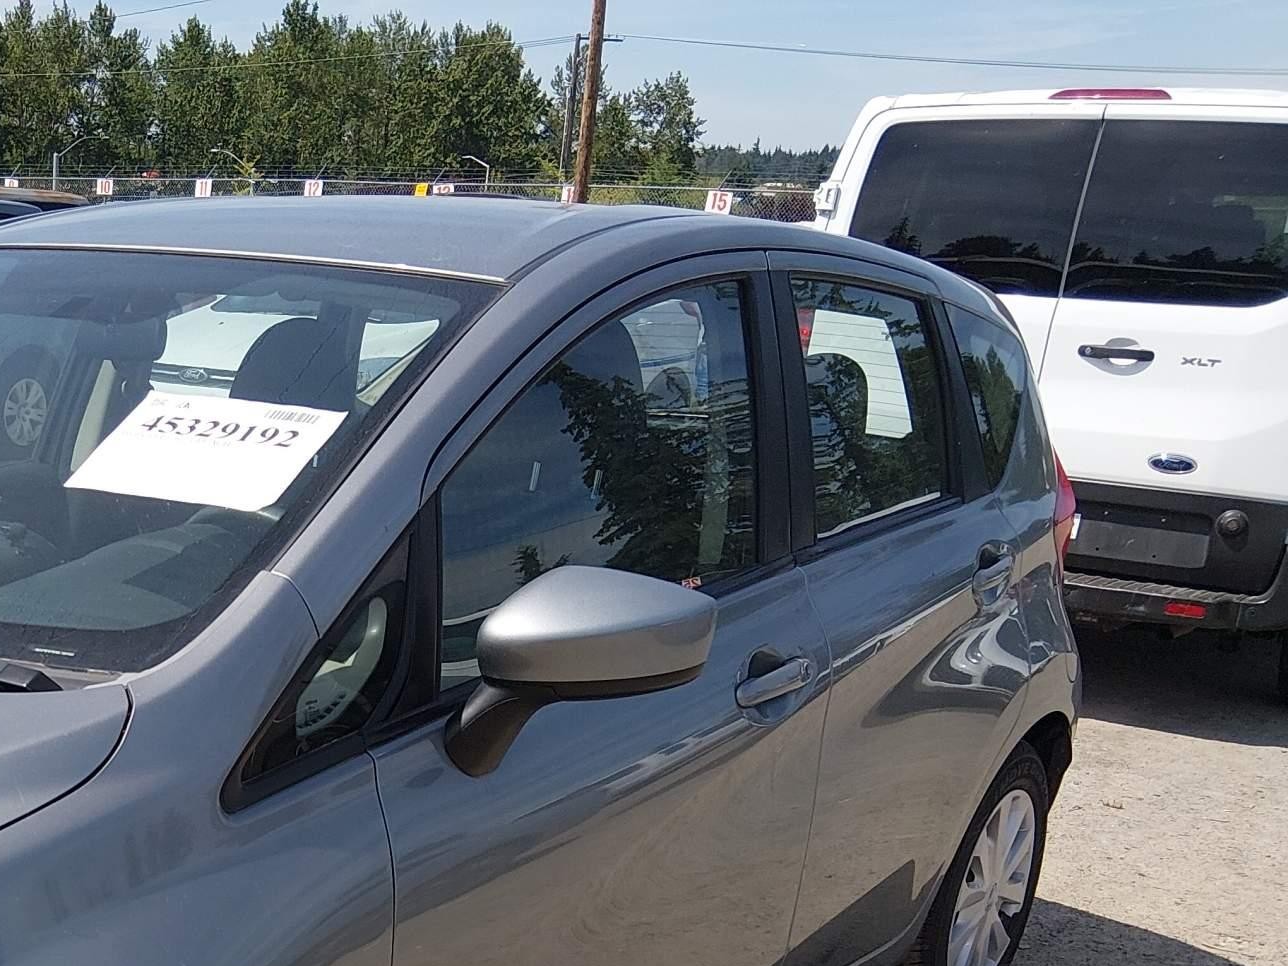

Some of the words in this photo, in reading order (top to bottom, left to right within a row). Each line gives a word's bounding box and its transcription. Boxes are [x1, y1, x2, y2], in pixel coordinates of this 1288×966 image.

[100, 180, 111, 193] 10
[199, 180, 208, 195] 11
[308, 181, 320, 195] 12
[711, 192, 729, 211] 15
[1180, 356, 1222, 368] XLT
[141, 414, 300, 448] 45329192
